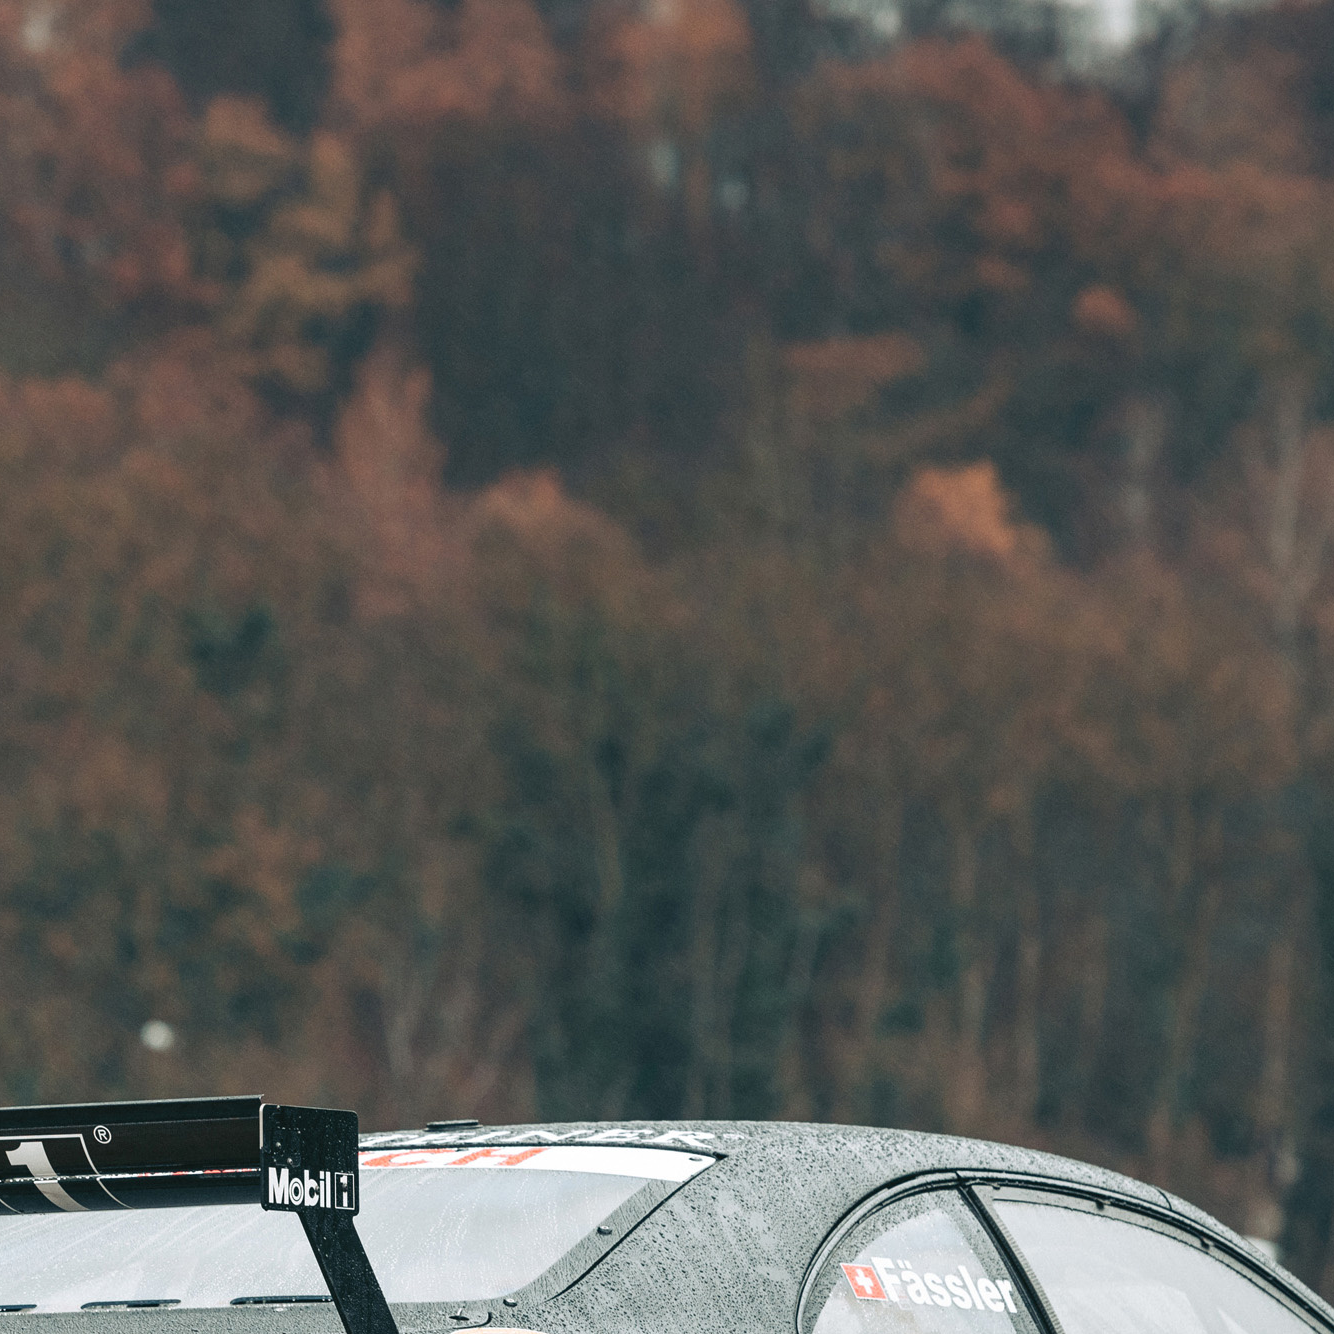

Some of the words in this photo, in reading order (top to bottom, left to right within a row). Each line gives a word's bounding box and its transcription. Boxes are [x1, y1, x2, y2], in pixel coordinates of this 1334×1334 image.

[5, 1141, 91, 1211] 1
[358, 1147, 551, 1167] CH
[268, 1167, 331, 1209] Mobil
[870, 1256, 1017, 1313] Fässler
